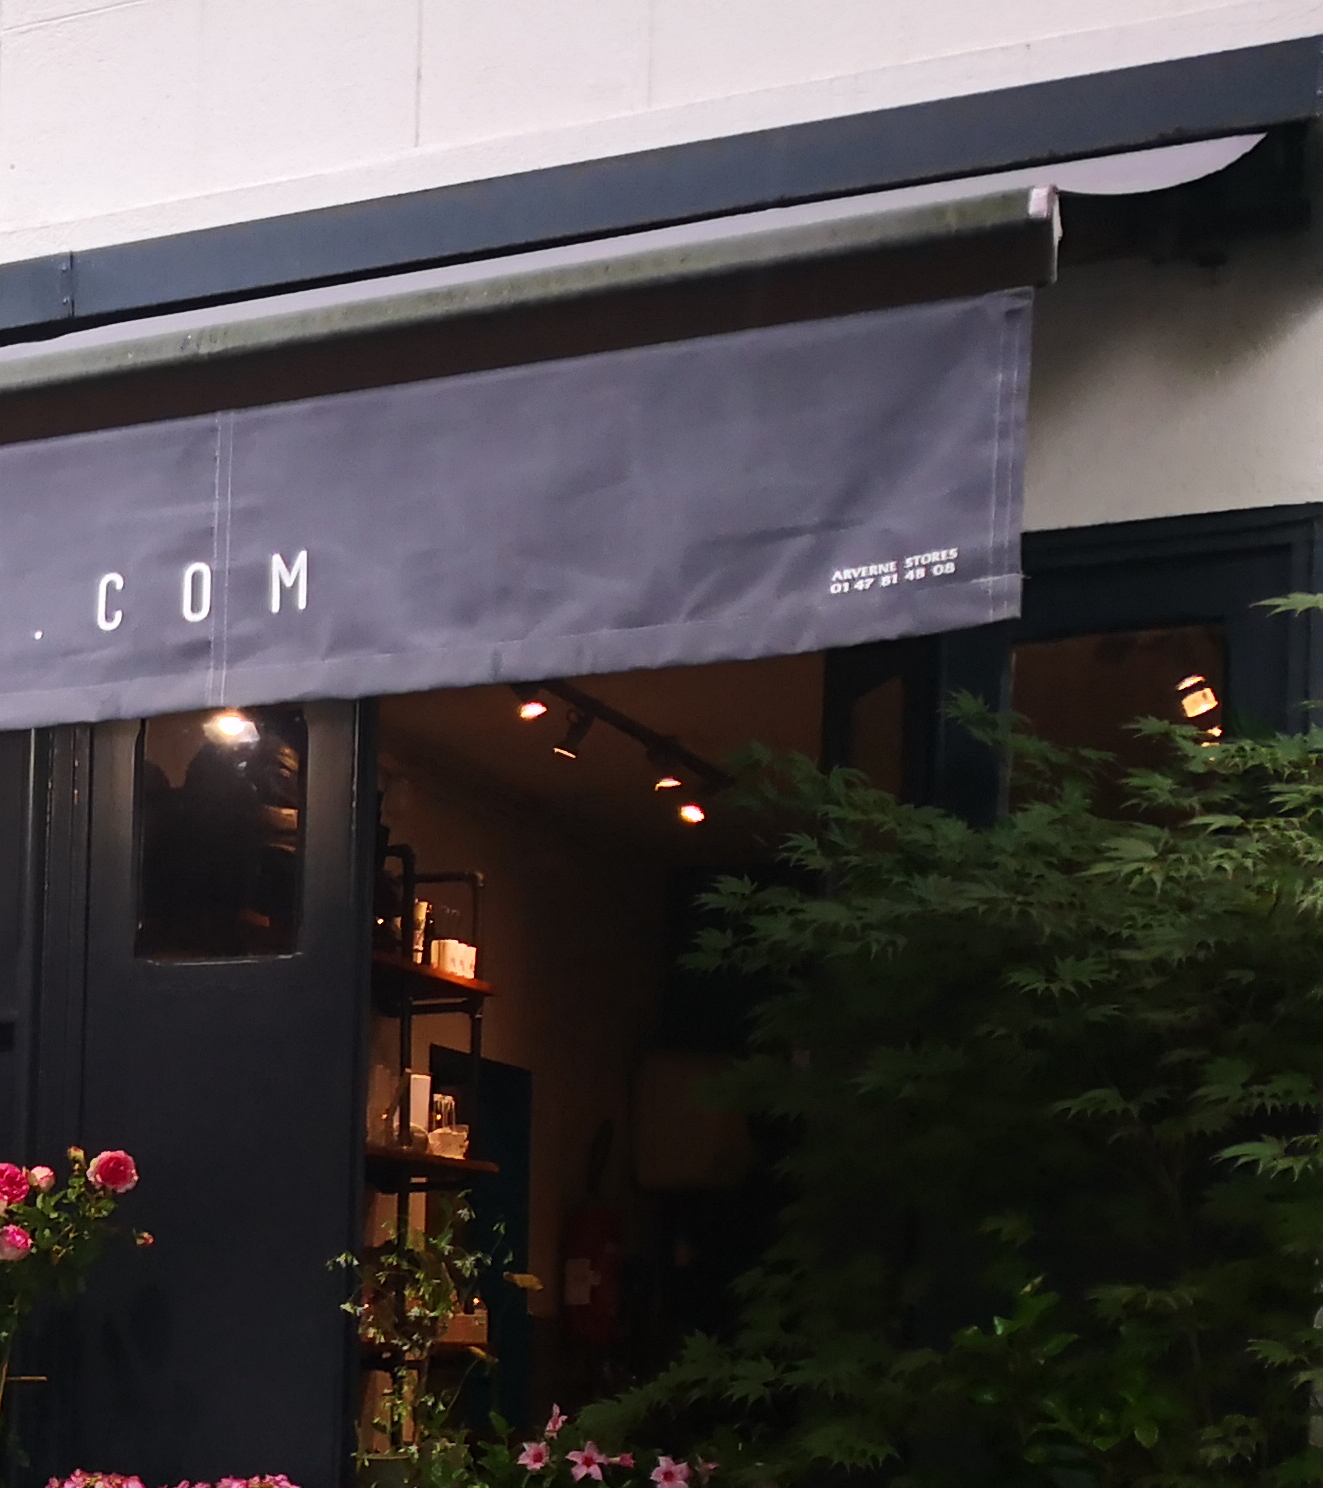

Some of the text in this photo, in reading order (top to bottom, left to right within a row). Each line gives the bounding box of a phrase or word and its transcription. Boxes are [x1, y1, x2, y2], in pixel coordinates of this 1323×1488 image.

[830, 581, 850, 594] 01
[853, 577, 875, 591] 47
[932, 562, 956, 577] 08
[831, 548, 958, 582] ARVERNE STORES
